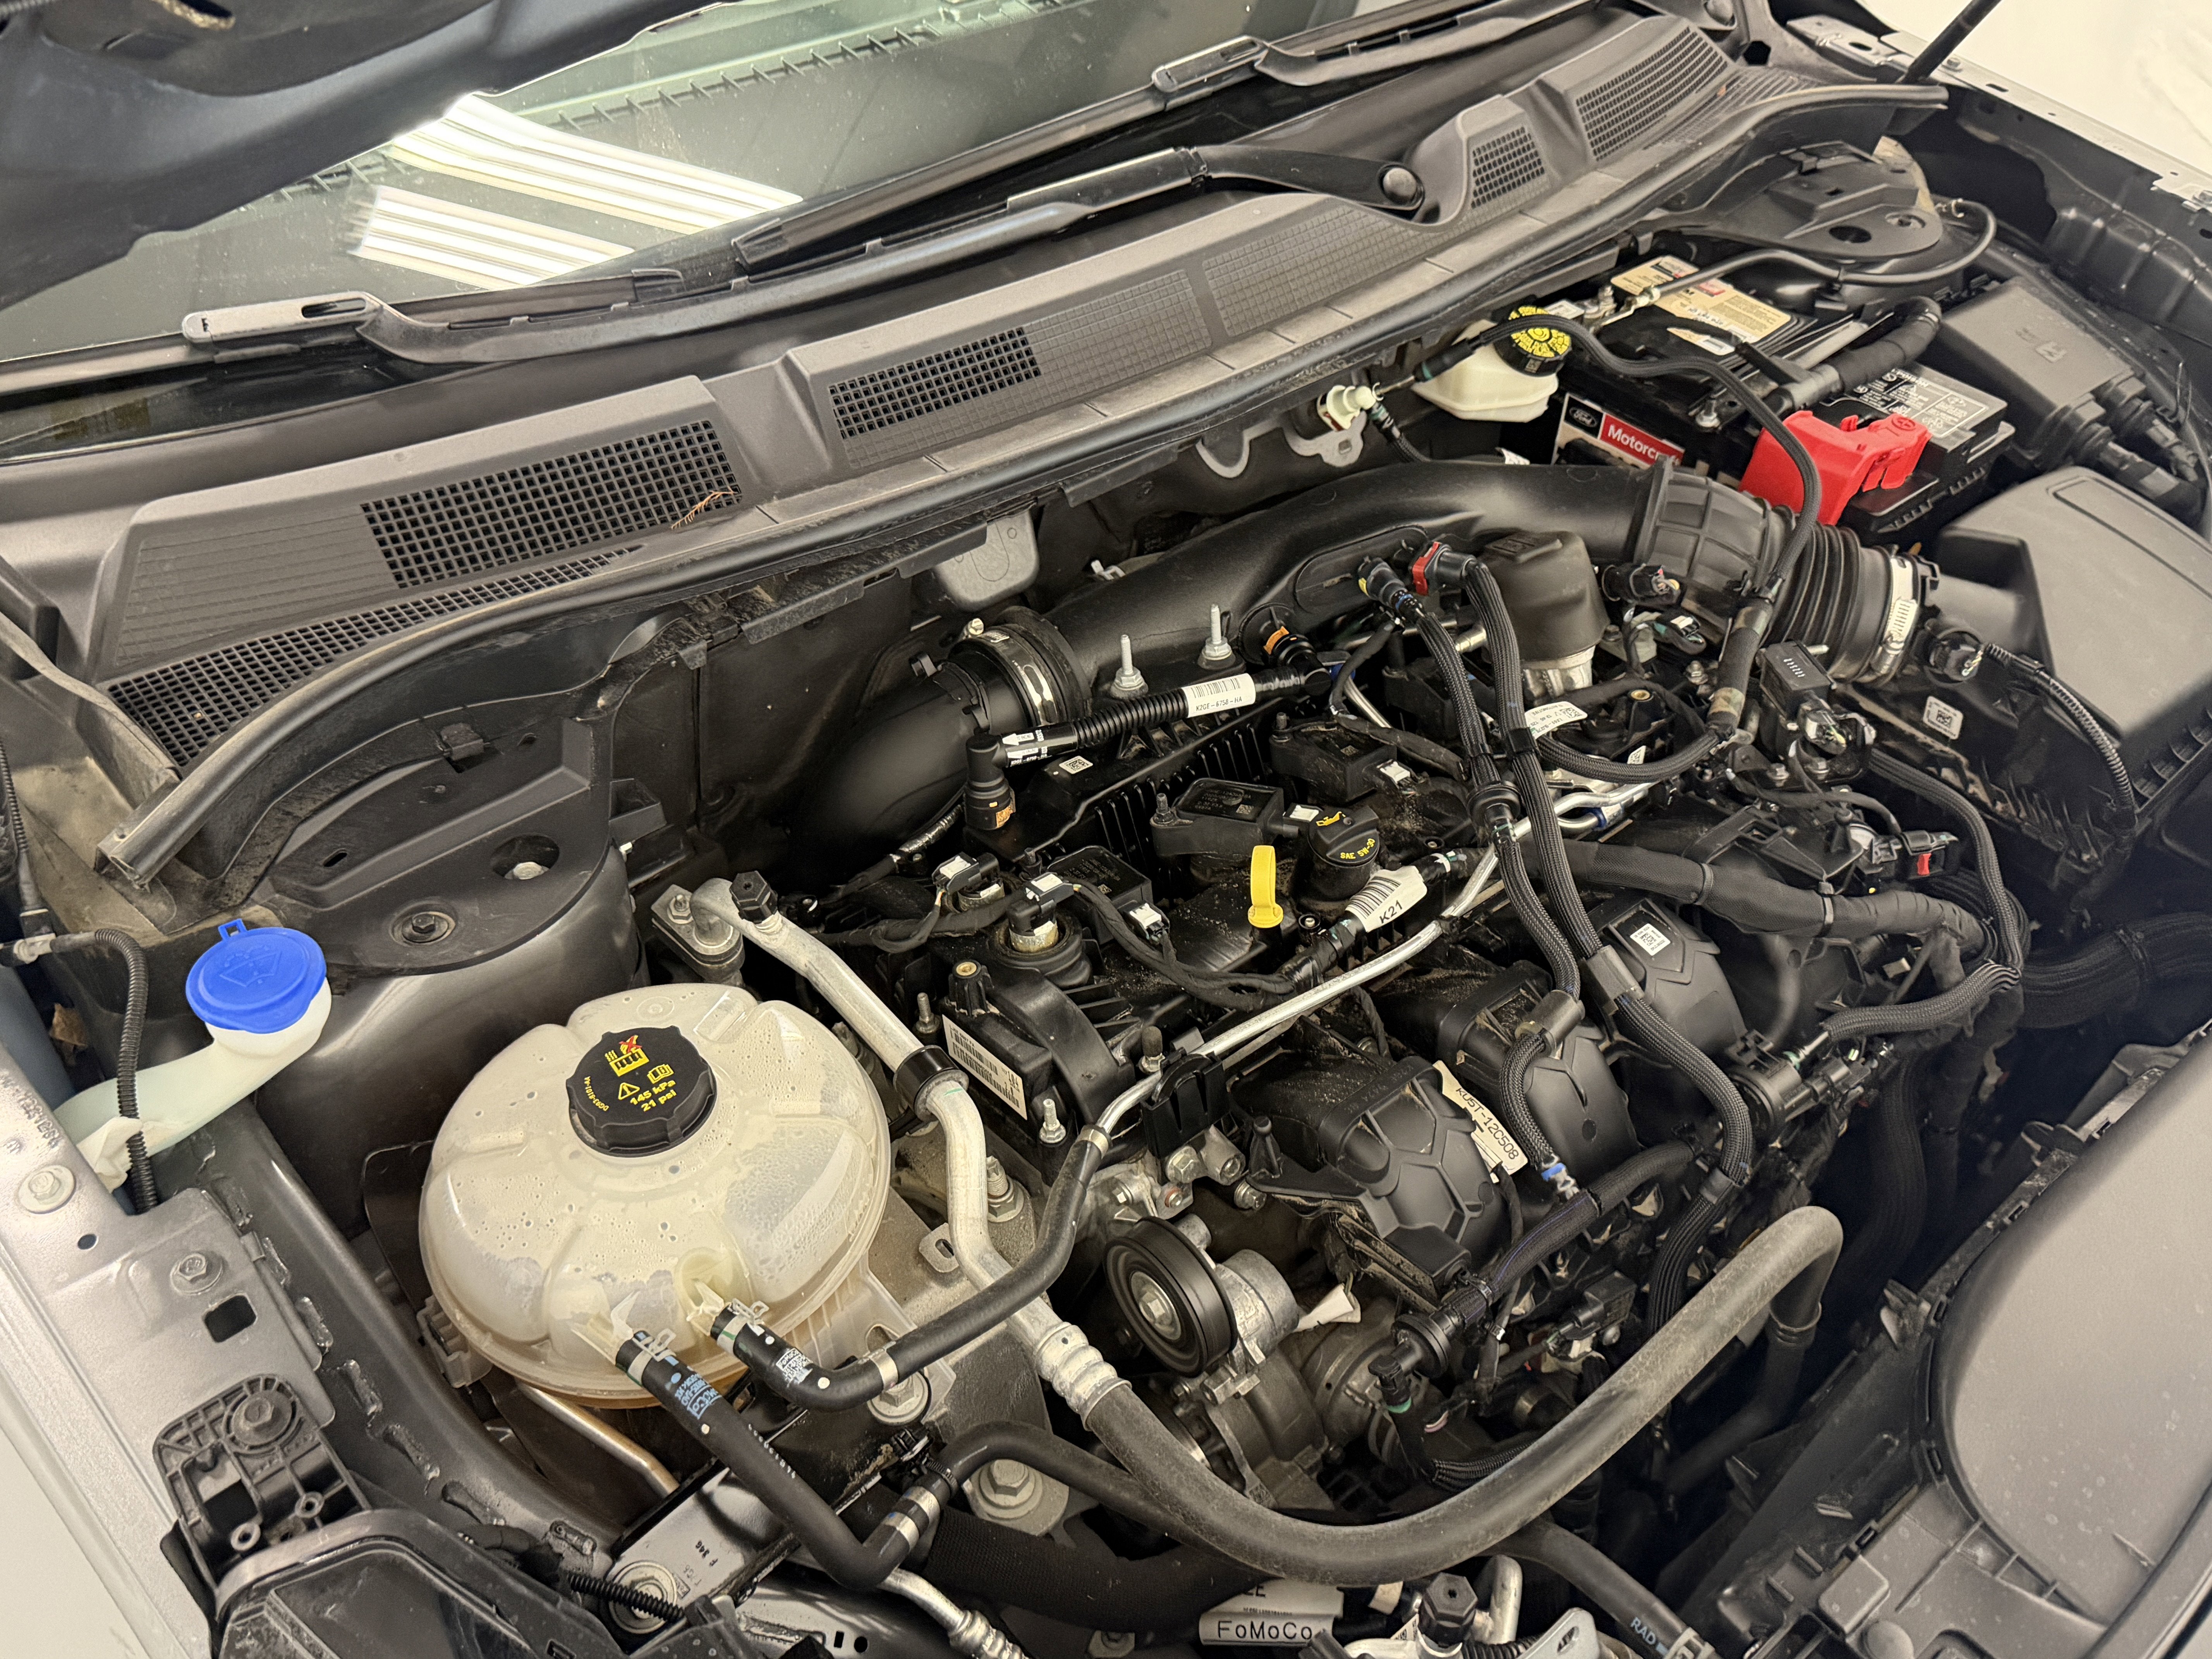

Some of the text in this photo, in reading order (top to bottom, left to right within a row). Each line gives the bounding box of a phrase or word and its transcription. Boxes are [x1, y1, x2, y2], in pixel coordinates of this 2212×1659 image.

[1357, 838, 1376, 857] 5W-30
[1379, 899, 1403, 924] K21
[584, 1076, 609, 1112] DG93-8101-AA
[630, 1080, 676, 1105] 145 kPa
[641, 1089, 678, 1112] 21 psi
[1455, 1087, 1519, 1160] KU5T-12C508
[1217, 1620, 1313, 1640] FoMoCo
[1631, 1616, 1656, 1645] RAD
